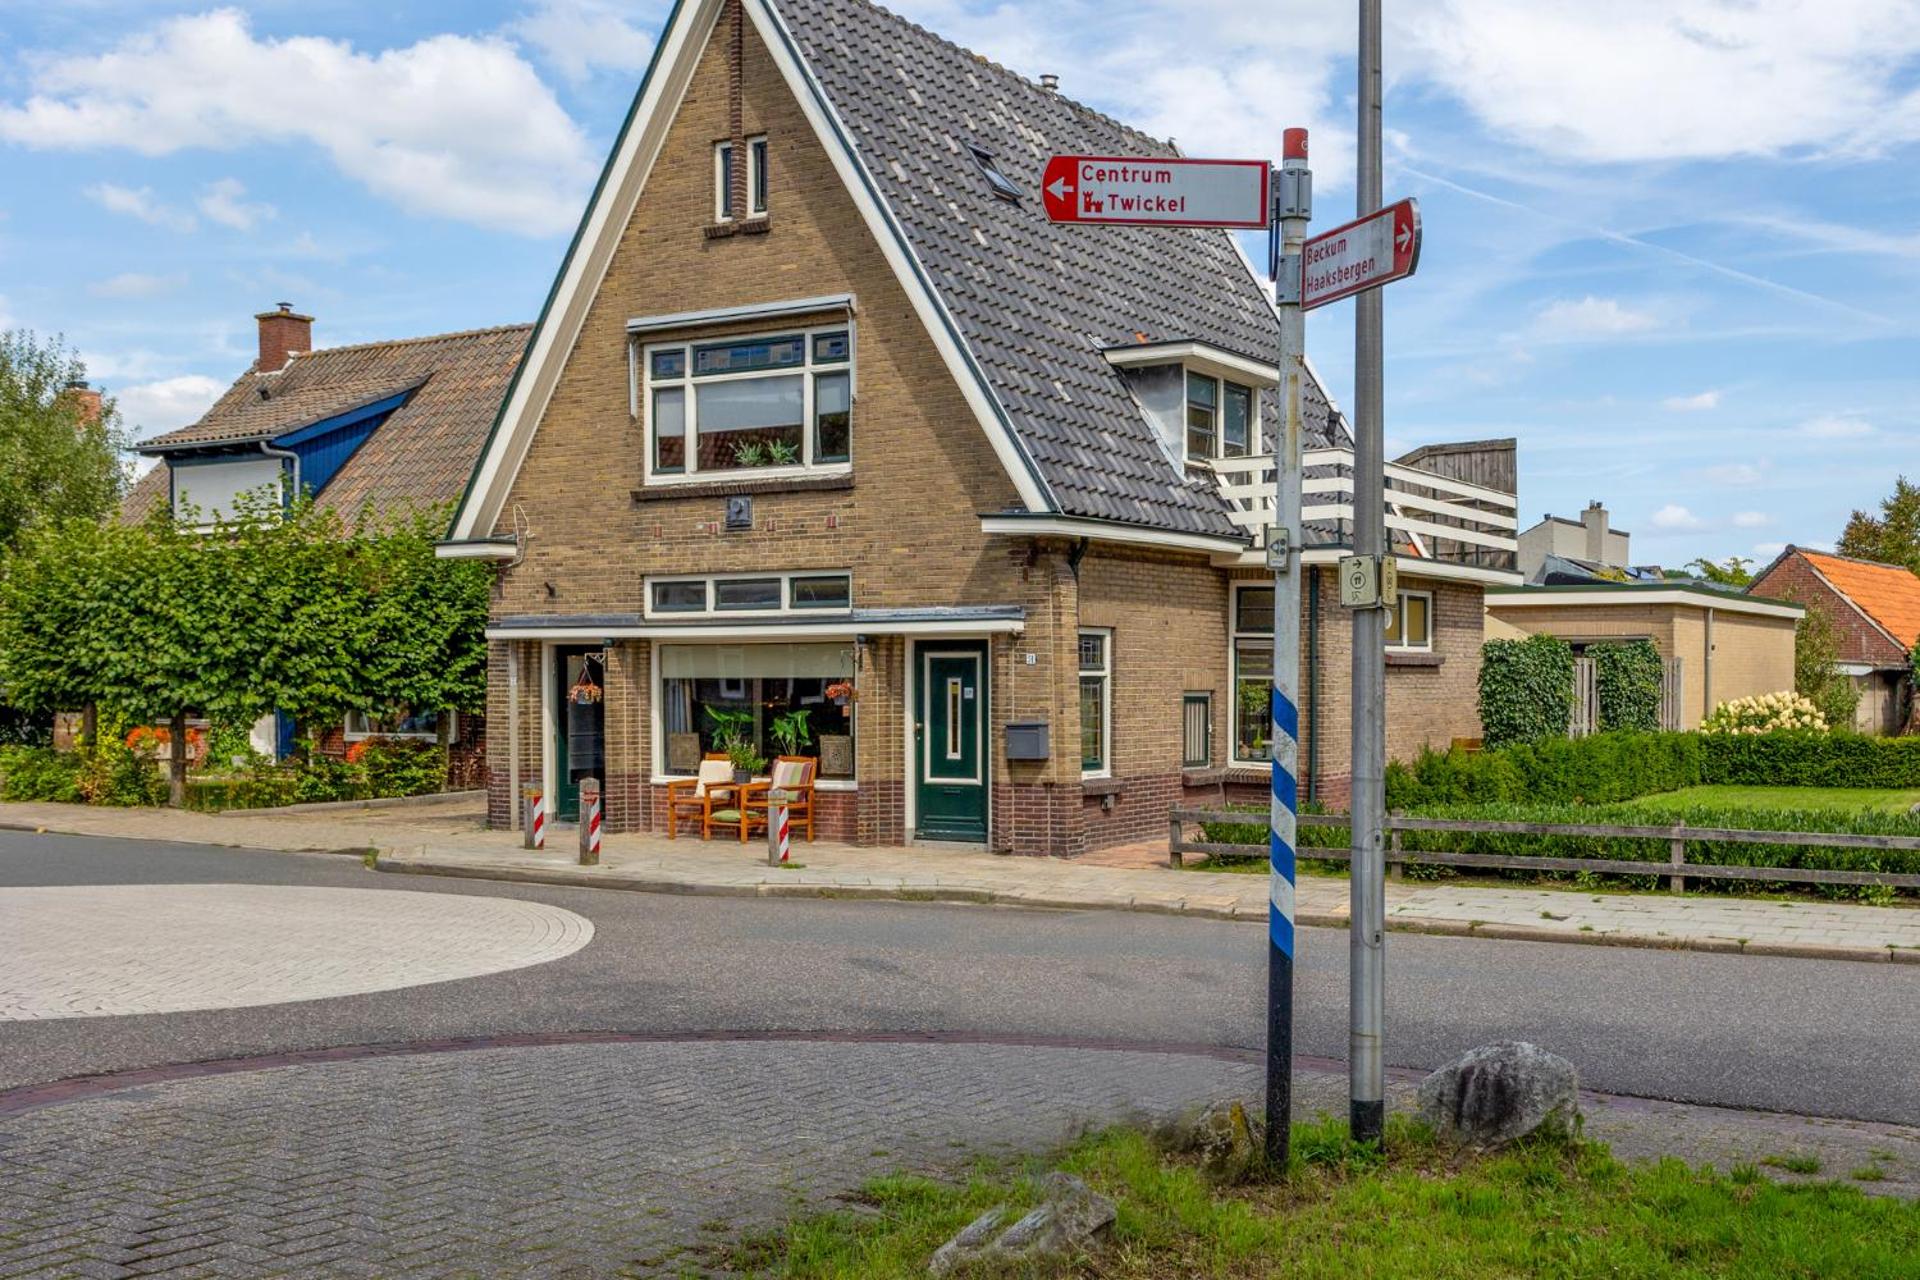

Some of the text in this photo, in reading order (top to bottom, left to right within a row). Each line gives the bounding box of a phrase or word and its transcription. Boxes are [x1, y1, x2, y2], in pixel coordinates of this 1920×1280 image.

[1082, 165, 1171, 183] Centrum
[1108, 194, 1185, 212] Twickel
[1307, 239, 1346, 266] Beckum
[1307, 257, 1375, 293] Haaksbergen
